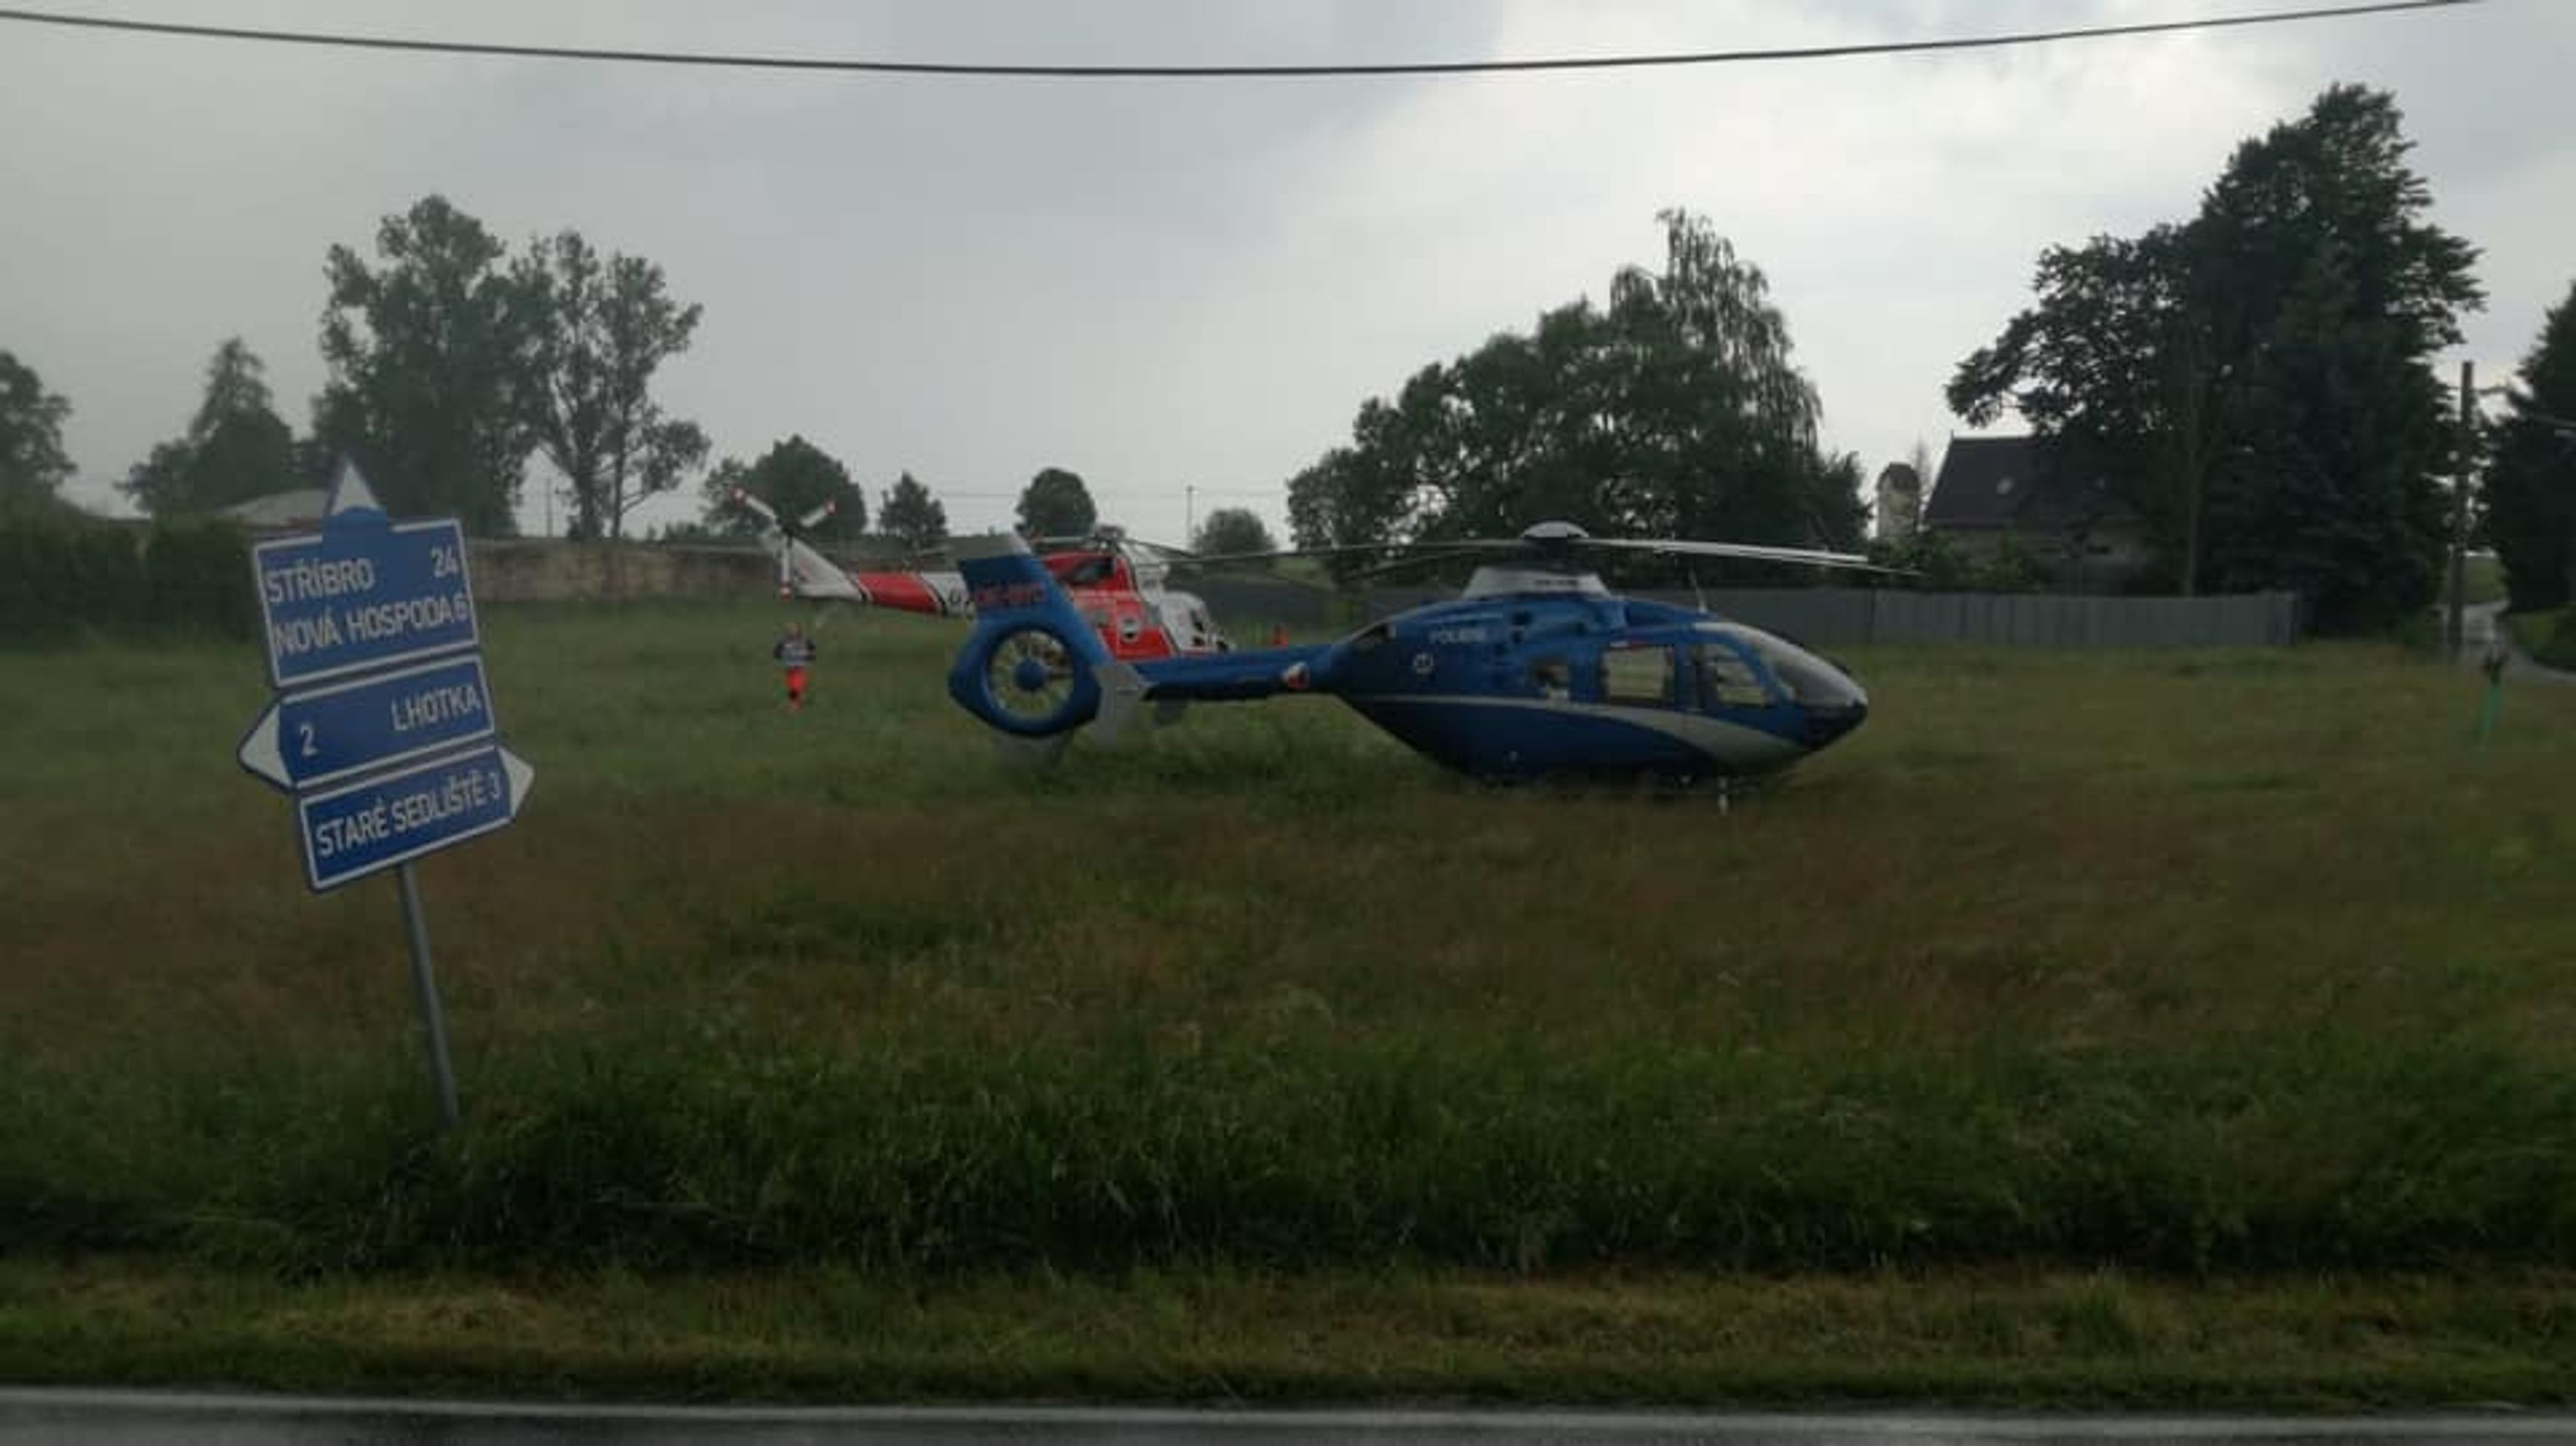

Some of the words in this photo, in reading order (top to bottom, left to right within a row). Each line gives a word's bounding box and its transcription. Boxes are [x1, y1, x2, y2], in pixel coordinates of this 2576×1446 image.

[265, 557, 374, 602] STŘÍBRO
[431, 545, 459, 578] 24
[274, 606, 342, 655] NOVÁ
[346, 596, 453, 640] HOSPODA
[450, 592, 470, 621] 6
[1430, 627, 1487, 645] POLI
[300, 724, 317, 756] 2
[391, 685, 482, 732] LHOTKA
[315, 800, 389, 857] STARÉ
[392, 770, 488, 831] SEDLIŠTĚ
[490, 771, 501, 799] 3
